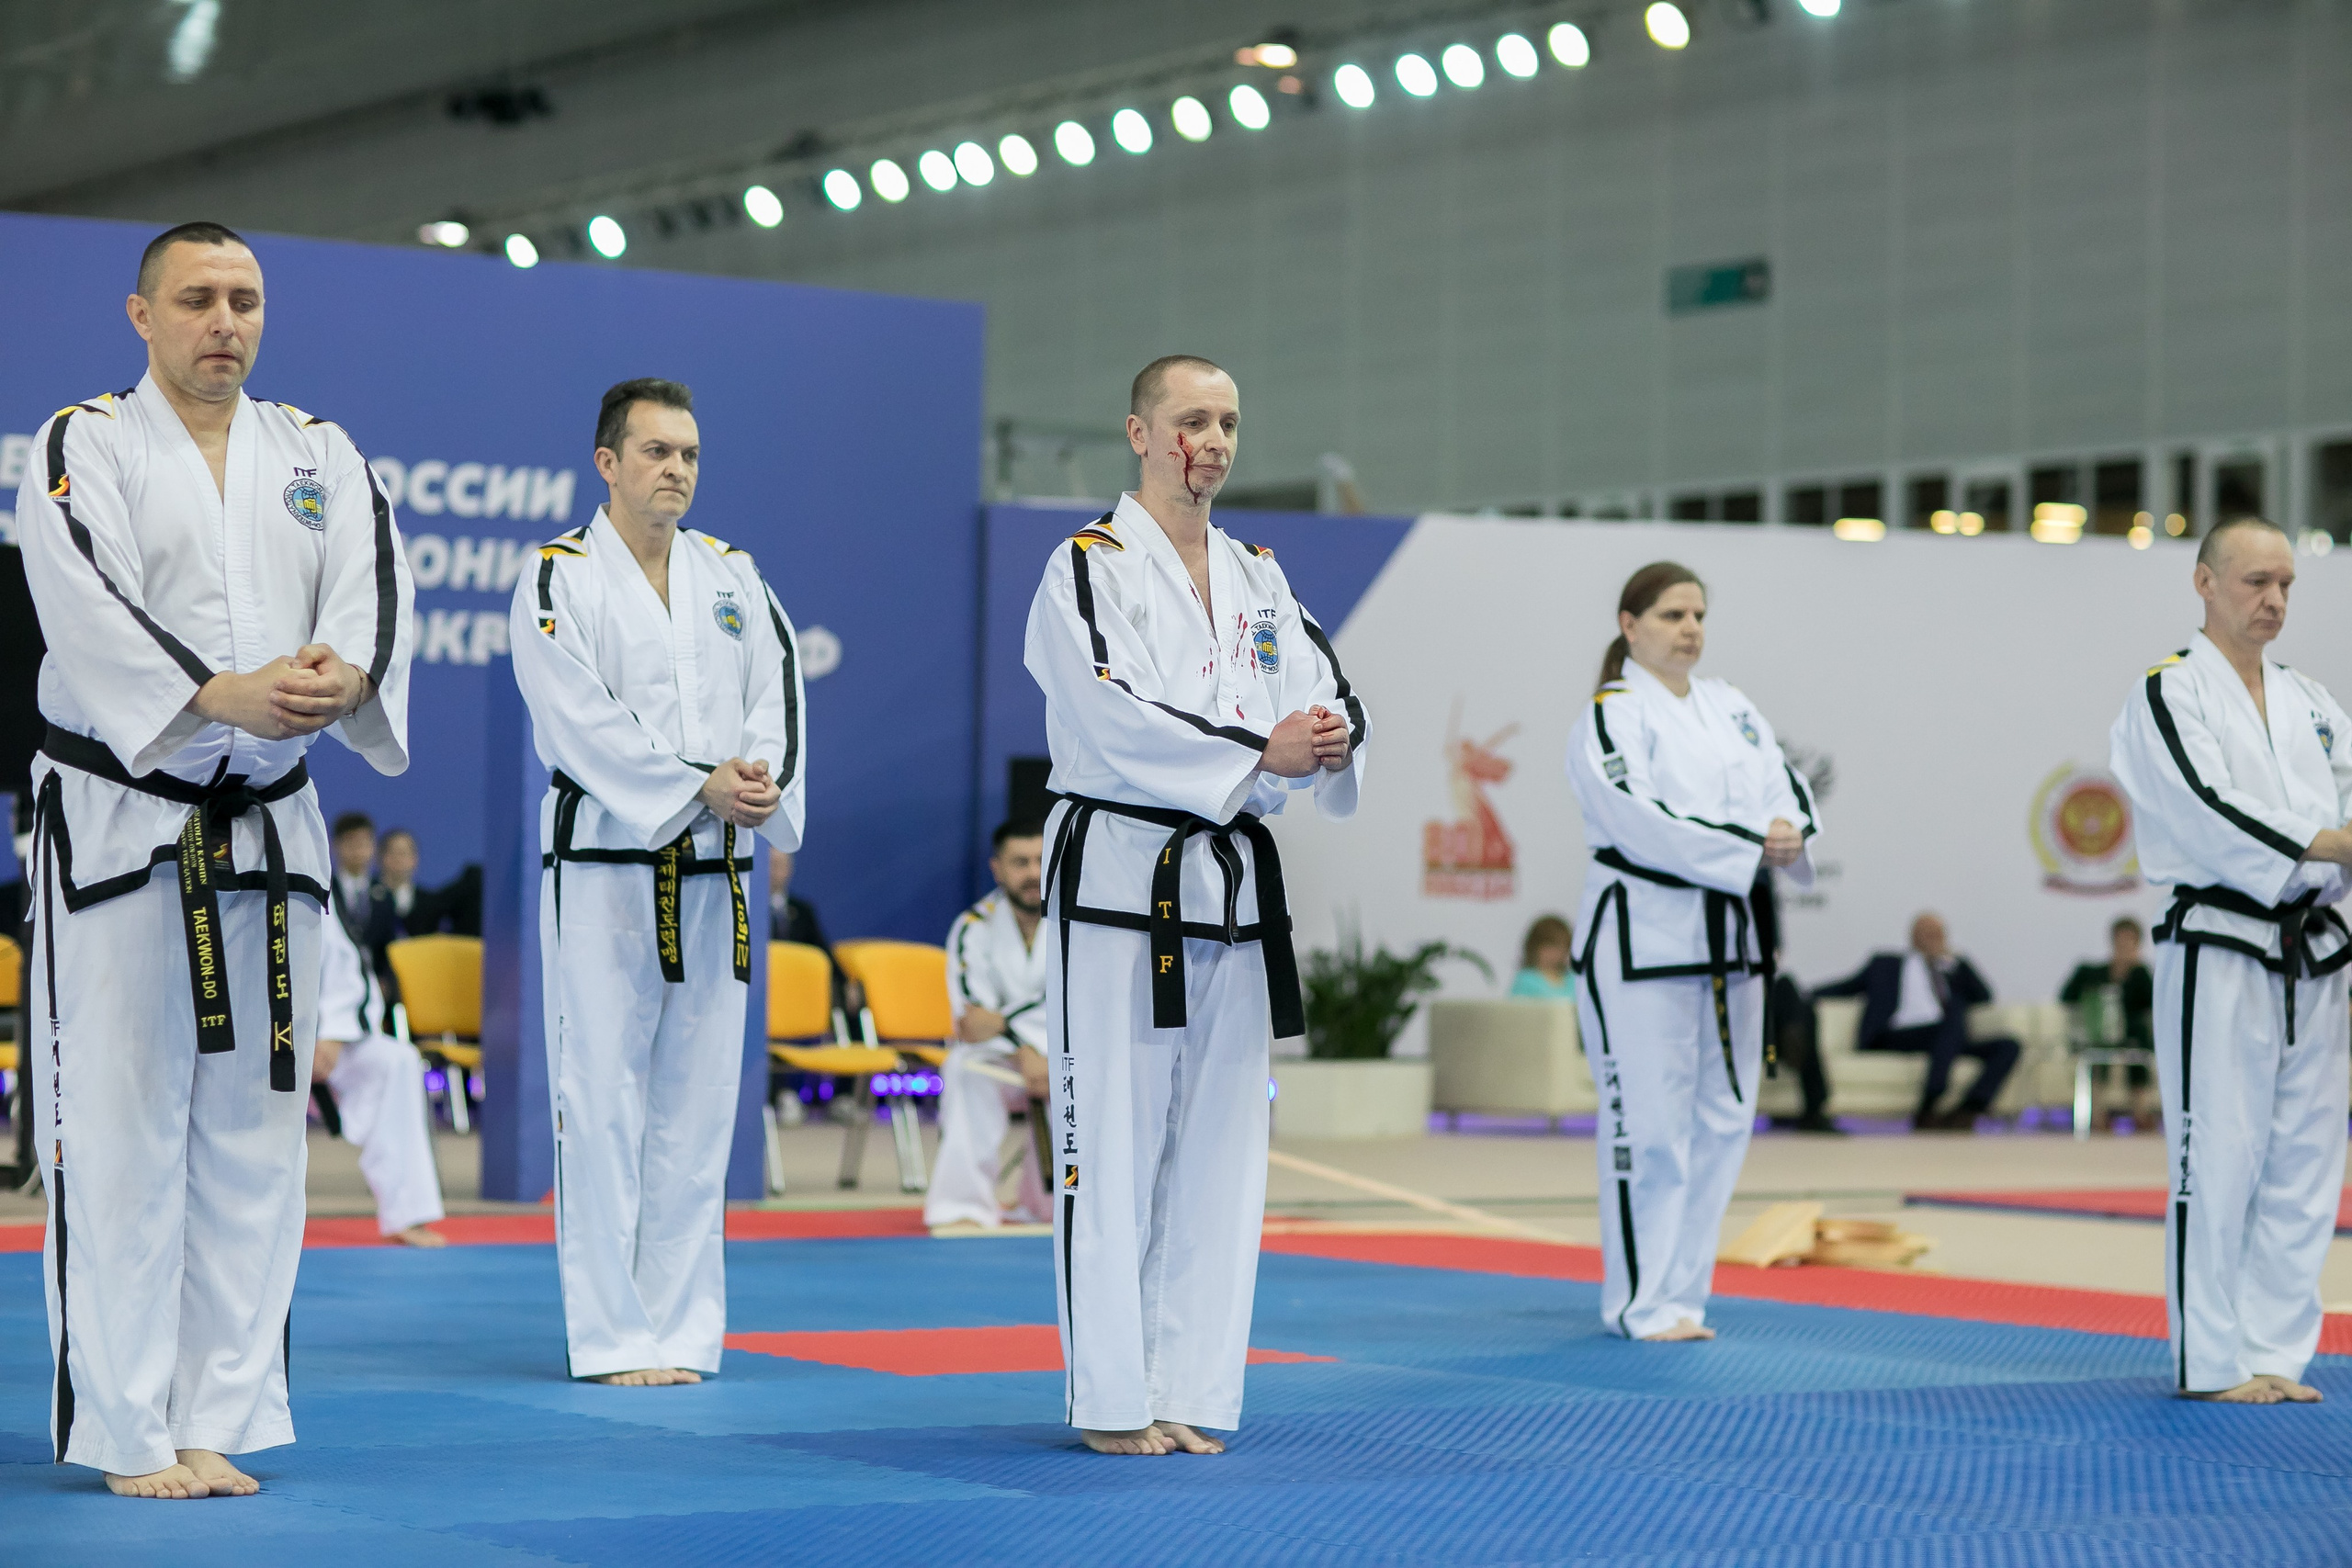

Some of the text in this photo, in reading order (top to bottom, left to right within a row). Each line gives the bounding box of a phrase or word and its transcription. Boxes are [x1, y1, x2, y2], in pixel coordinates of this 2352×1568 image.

[293, 467, 317, 478] ITF
[368, 457, 577, 522] ОССИИ
[401, 533, 544, 592] ОНИ
[716, 591, 735, 599] ITF
[1258, 609, 1276, 619] ITF
[727, 824, 741, 894] Fedoto
[193, 906, 218, 999] TAEKWON-DO
[201, 1014, 226, 1027] ITF
[1061, 1057, 1075, 1071] ITF
